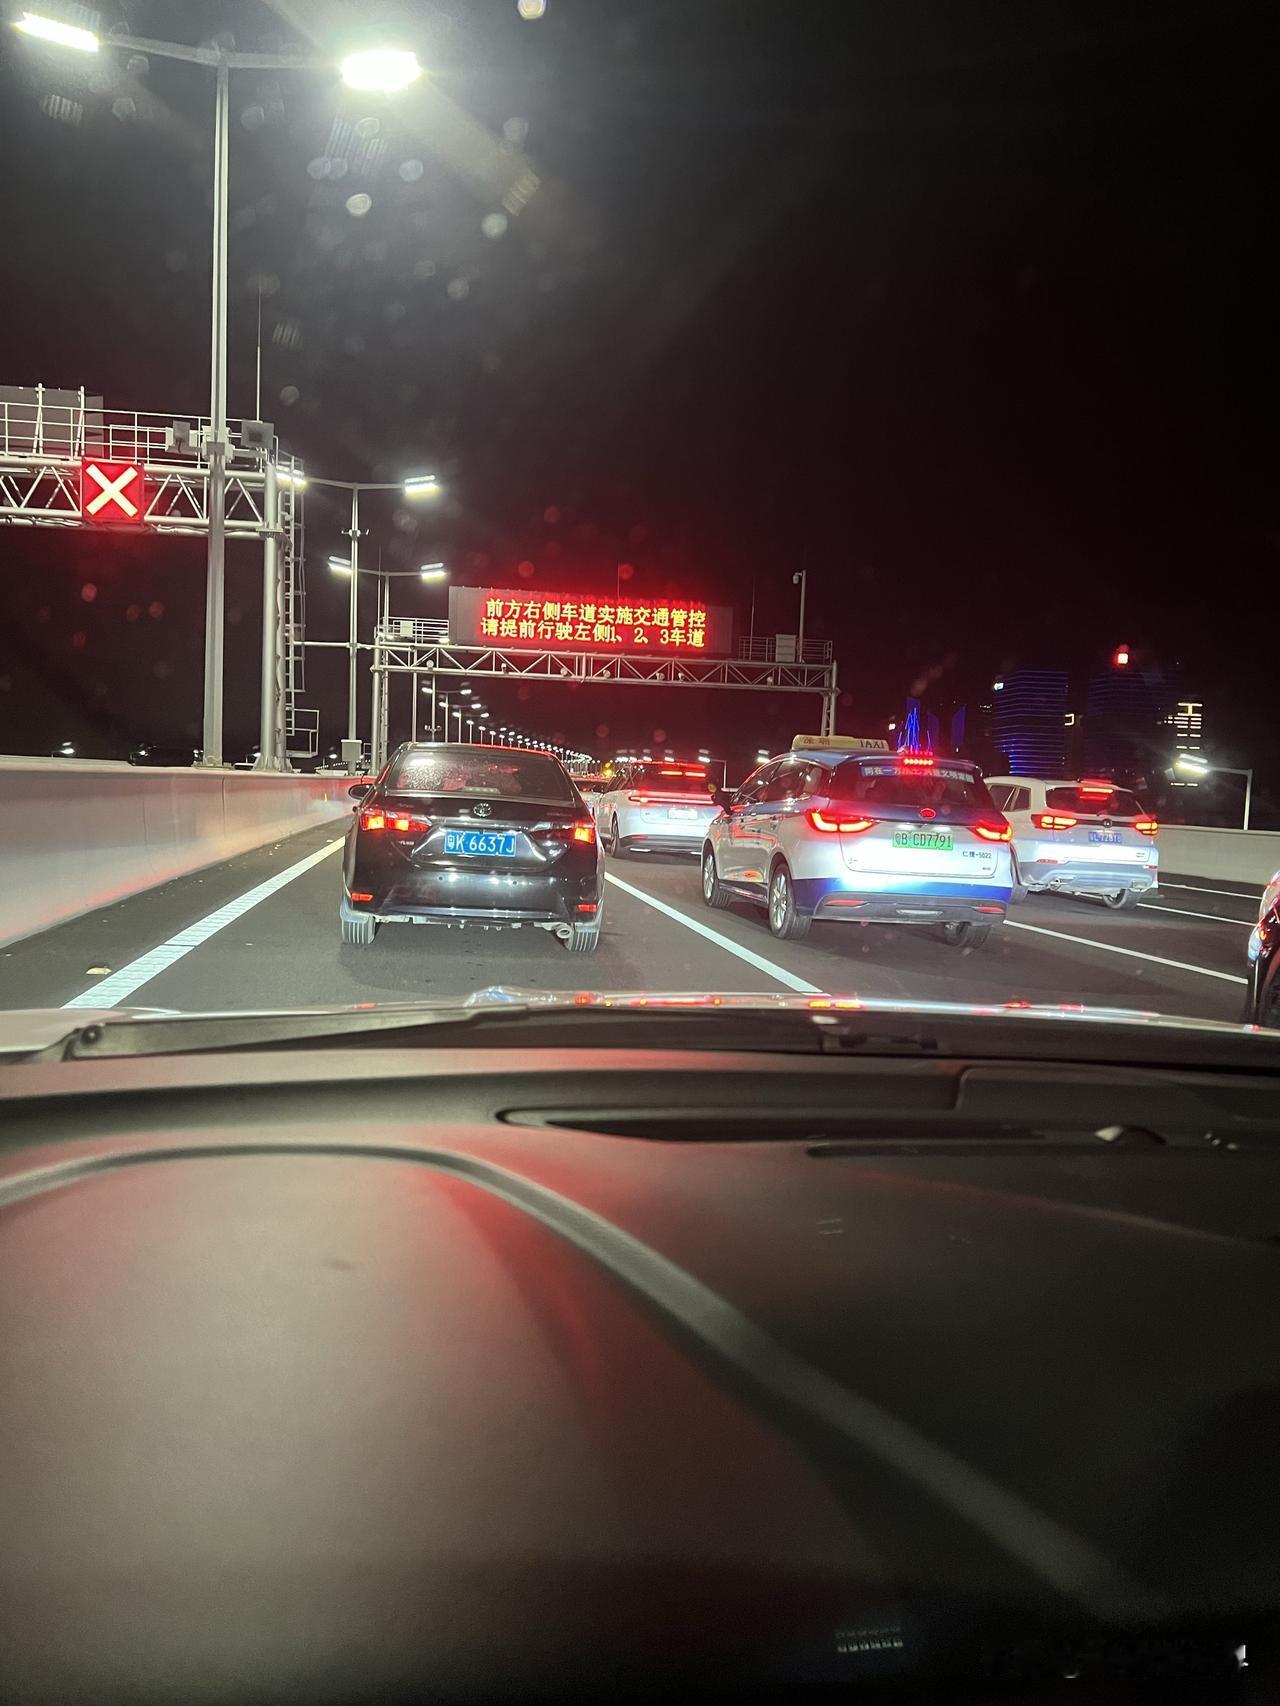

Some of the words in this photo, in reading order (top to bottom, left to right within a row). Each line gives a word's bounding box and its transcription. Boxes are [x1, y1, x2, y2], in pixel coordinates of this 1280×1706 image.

[486, 598, 706, 628] 前方右侧车道实施交通管控
